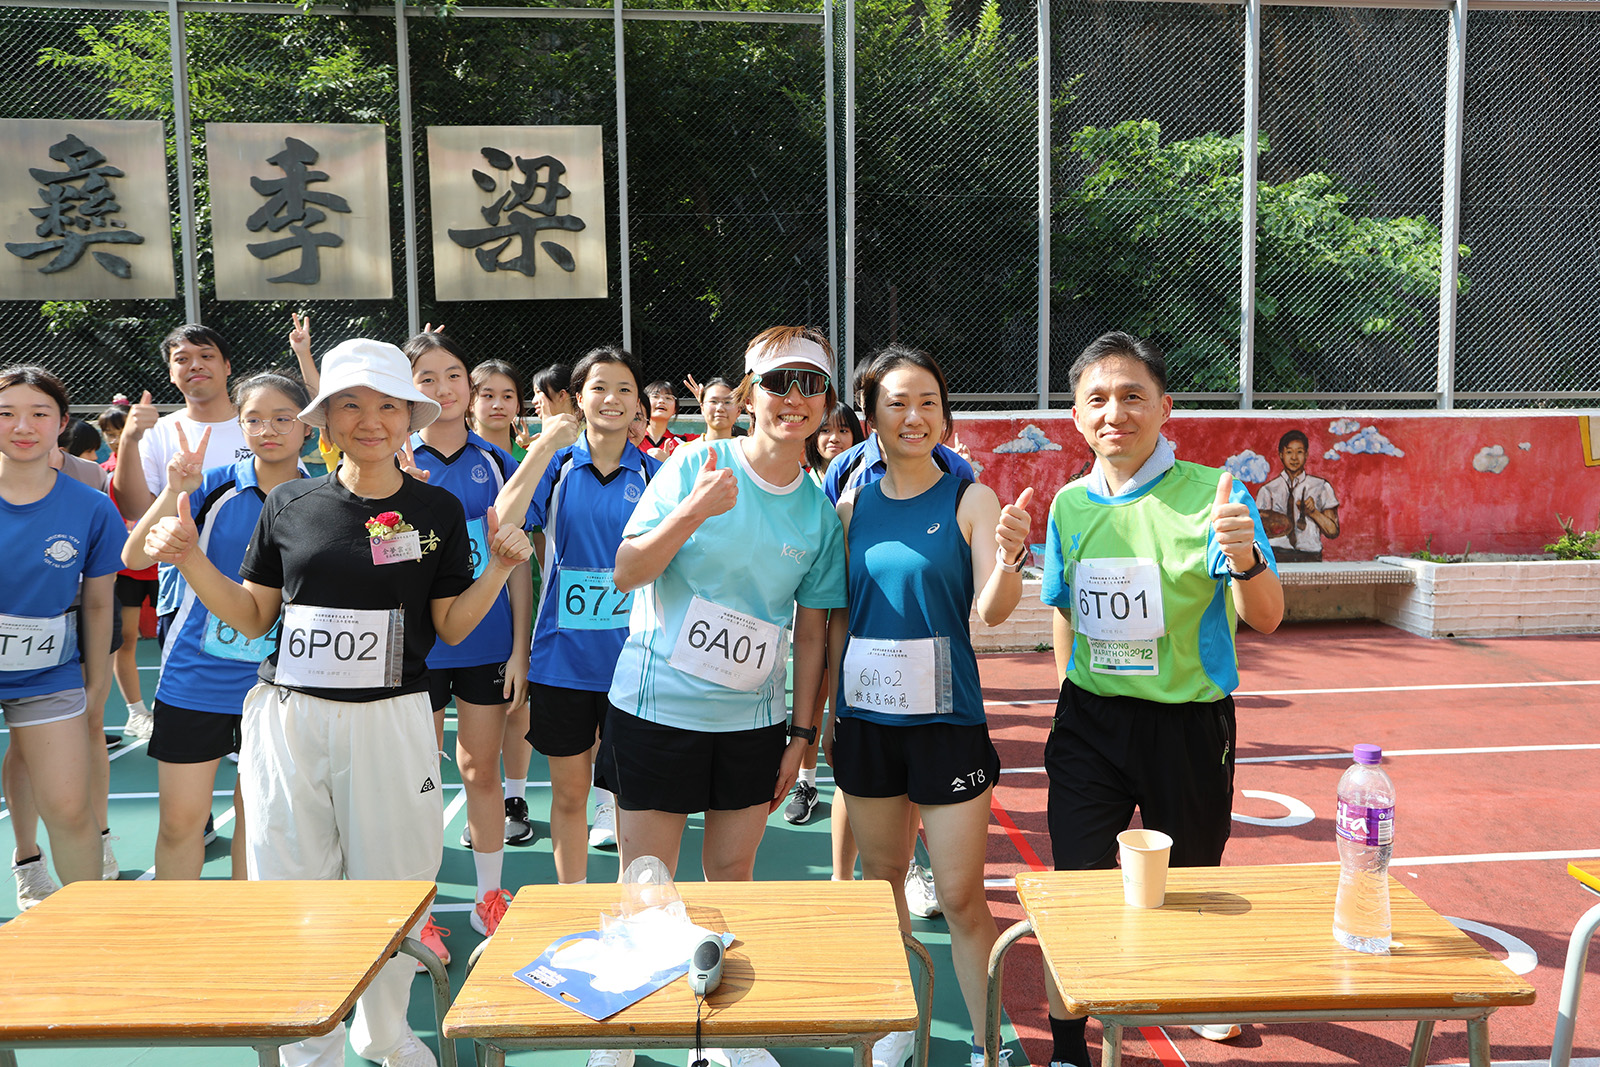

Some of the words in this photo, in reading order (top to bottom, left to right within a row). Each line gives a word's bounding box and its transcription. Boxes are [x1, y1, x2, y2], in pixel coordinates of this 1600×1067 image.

[565, 583, 630, 616] 672
[1079, 588, 1148, 620] 6T01
[288, 628, 379, 661] 6P02
[688, 620, 767, 670] 6A01
[1107, 642, 1129, 650] KONG
[966, 768, 986, 787] T8
